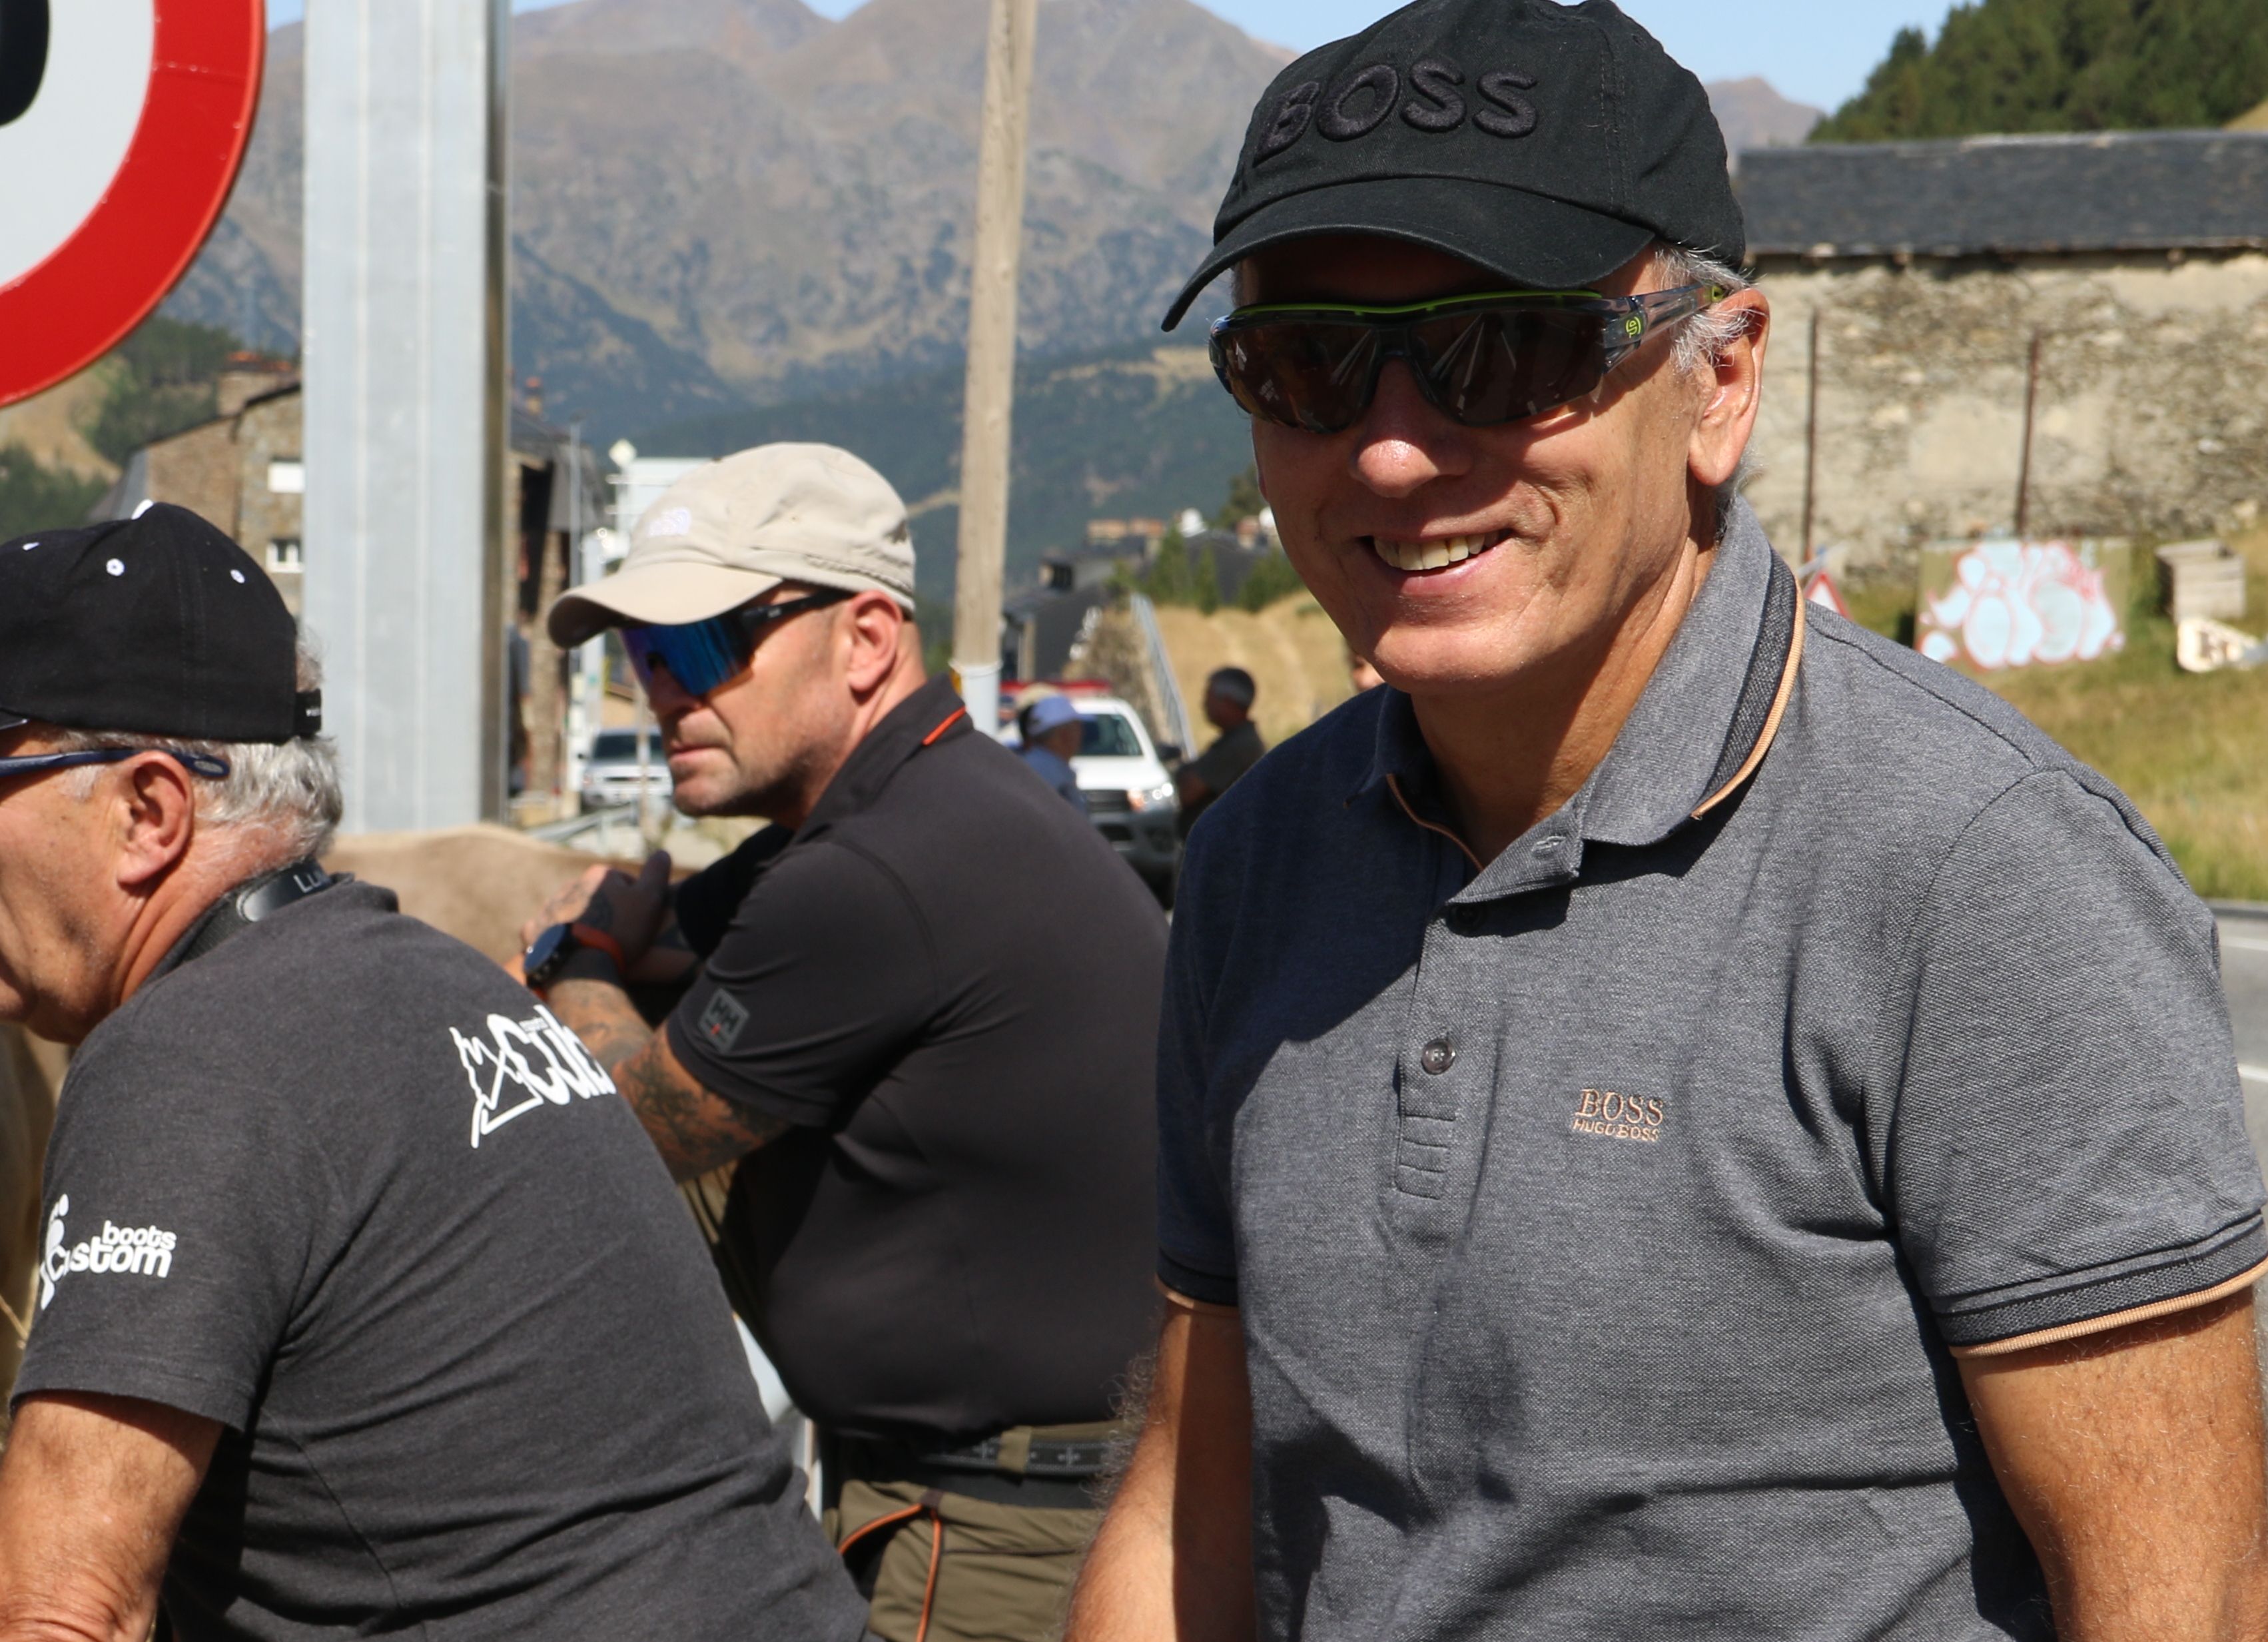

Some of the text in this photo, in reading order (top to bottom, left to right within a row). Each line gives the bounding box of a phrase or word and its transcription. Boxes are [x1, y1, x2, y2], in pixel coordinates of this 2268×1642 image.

[1252, 59, 1538, 168] BOSS
[1574, 1088, 1664, 1126] BOSS
[1573, 1118, 1660, 1142] HUGO BOSS
[102, 1220, 177, 1251] boots
